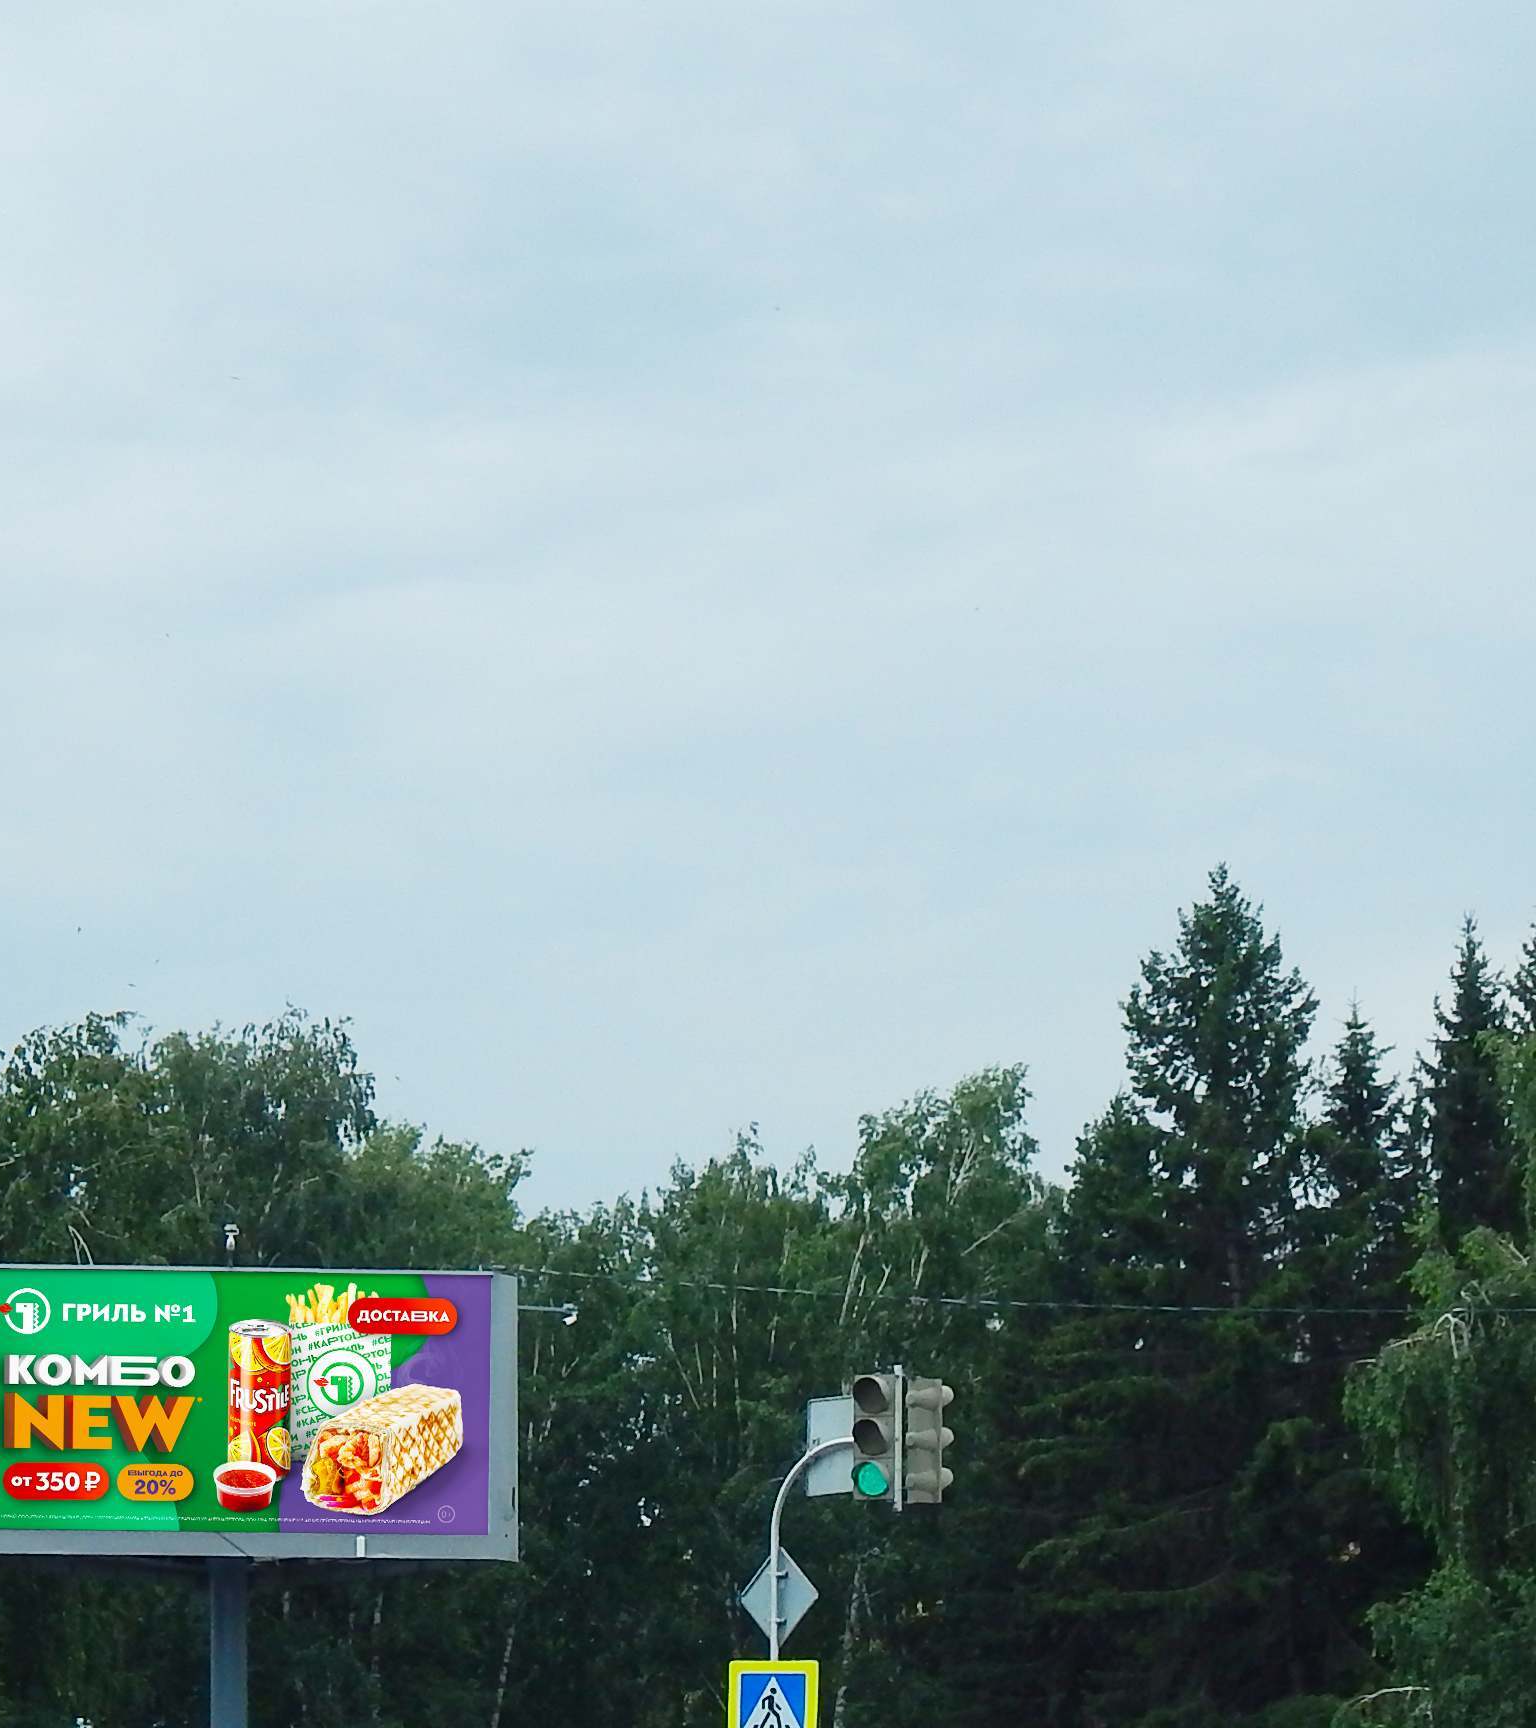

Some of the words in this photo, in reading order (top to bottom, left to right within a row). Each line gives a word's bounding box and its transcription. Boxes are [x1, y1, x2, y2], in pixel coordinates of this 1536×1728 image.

[62, 1303, 146, 1322] ГРИЛЬ
[154, 1304, 196, 1323] №1
[356, 1309, 450, 1324] ДОСТАВКА
[5, 1353, 196, 1388] КОМБО
[35, 1471, 81, 1492] 350
[169, 1470, 184, 1478] ДО
[134, 1479, 176, 1495] 20%
